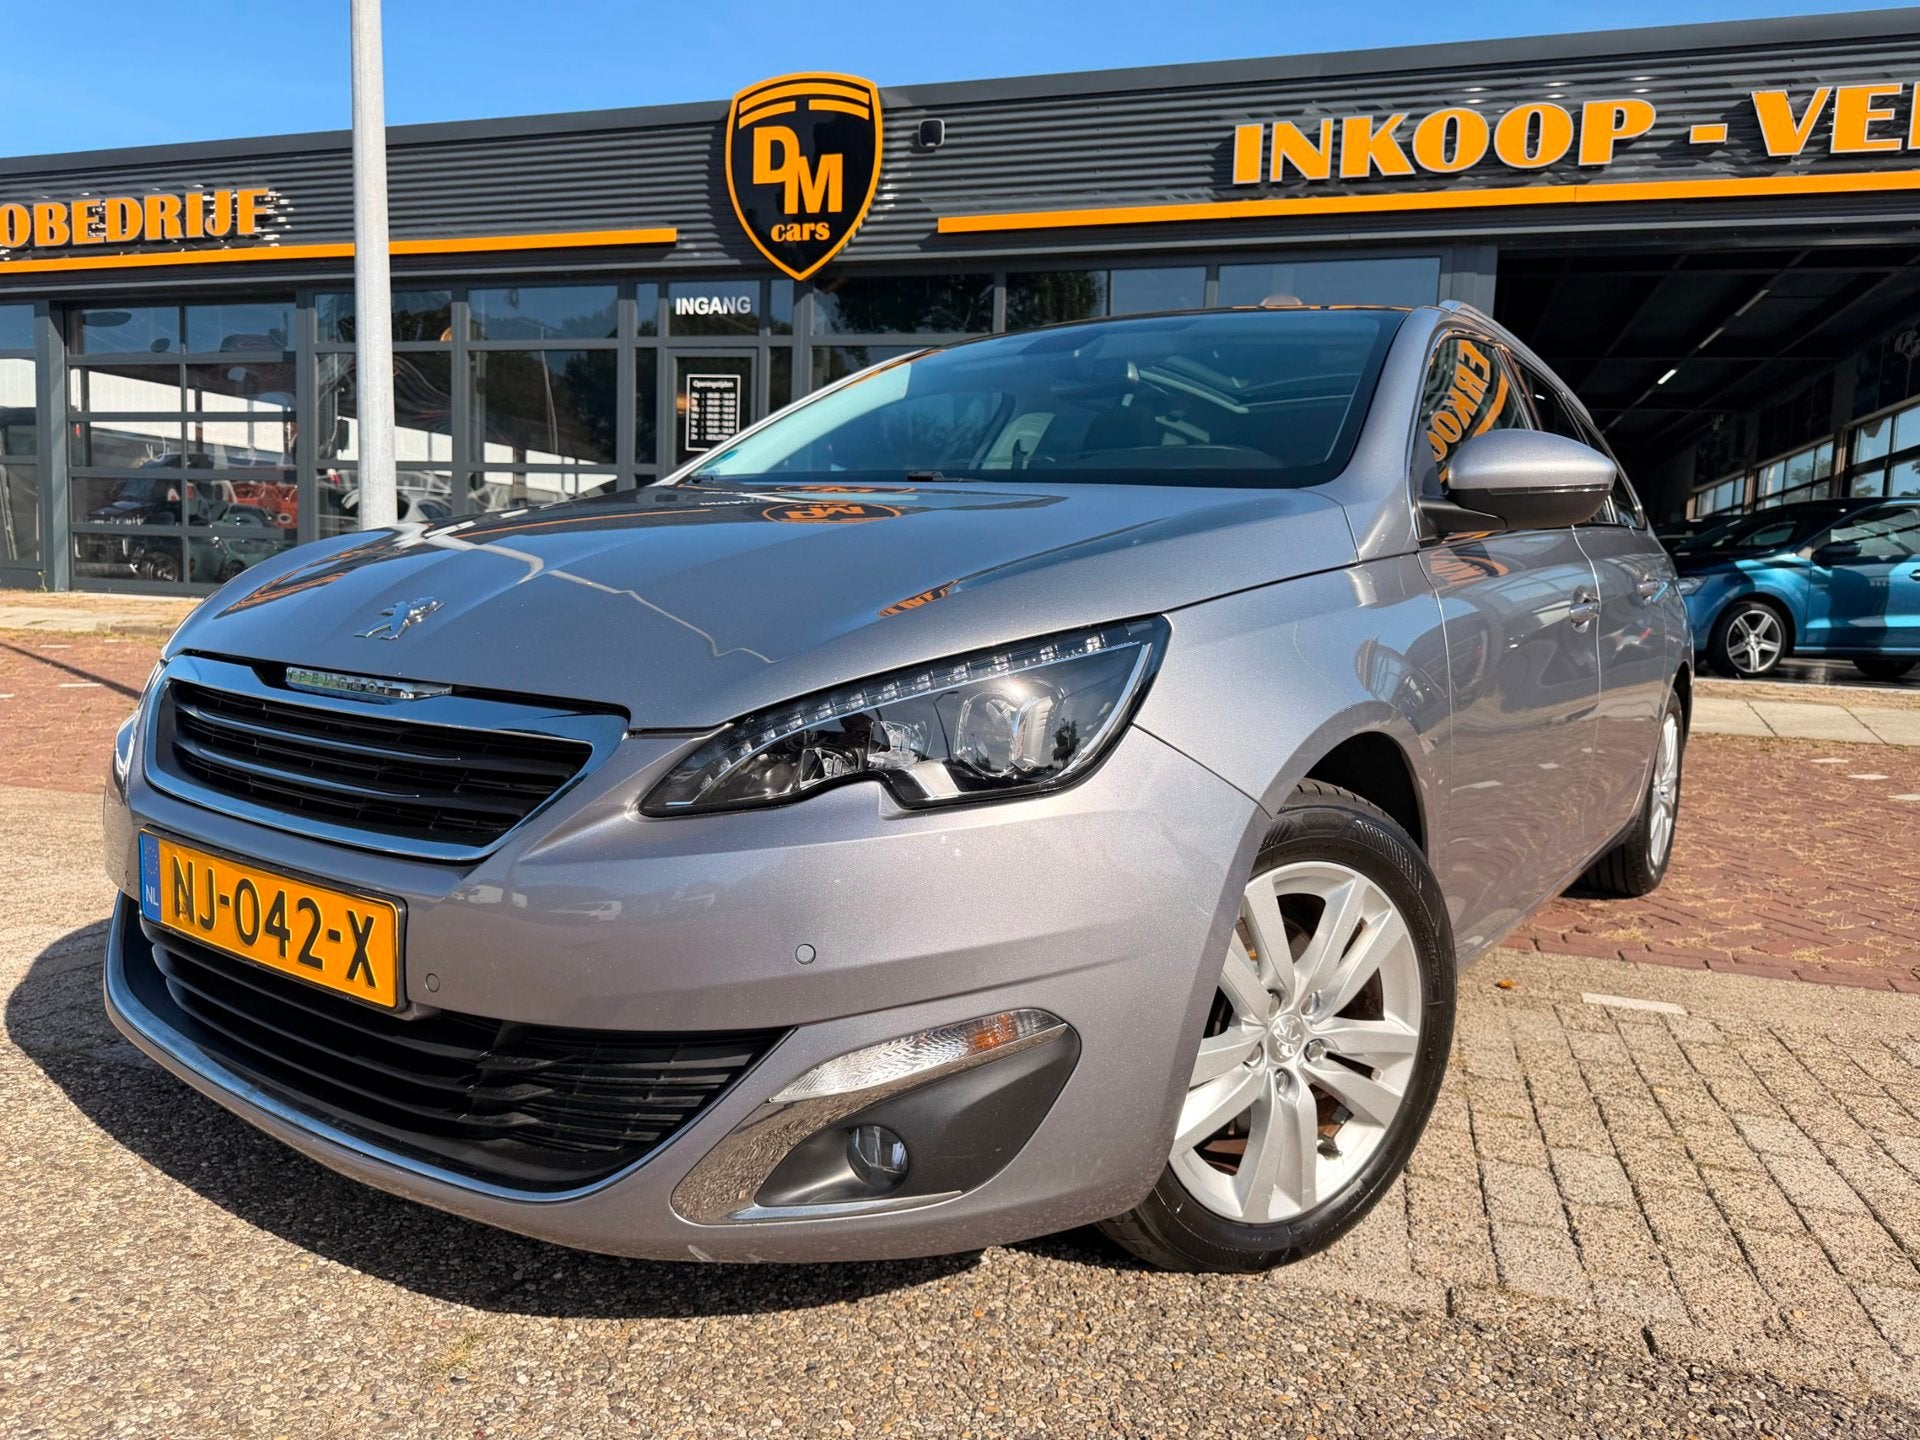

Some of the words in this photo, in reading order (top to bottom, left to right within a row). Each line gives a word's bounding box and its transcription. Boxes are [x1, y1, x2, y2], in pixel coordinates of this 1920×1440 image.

[1232, 98, 1657, 186] INKOOP
[1689, 122, 1729, 145] -
[1751, 81, 1920, 157] VE
[752, 125, 843, 215] DM
[0, 188, 269, 248] OBEDRIJF
[770, 221, 831, 243] cars
[675, 295, 752, 316] INGANG
[145, 883, 160, 907] NL
[172, 855, 377, 989] NJ-042-X
